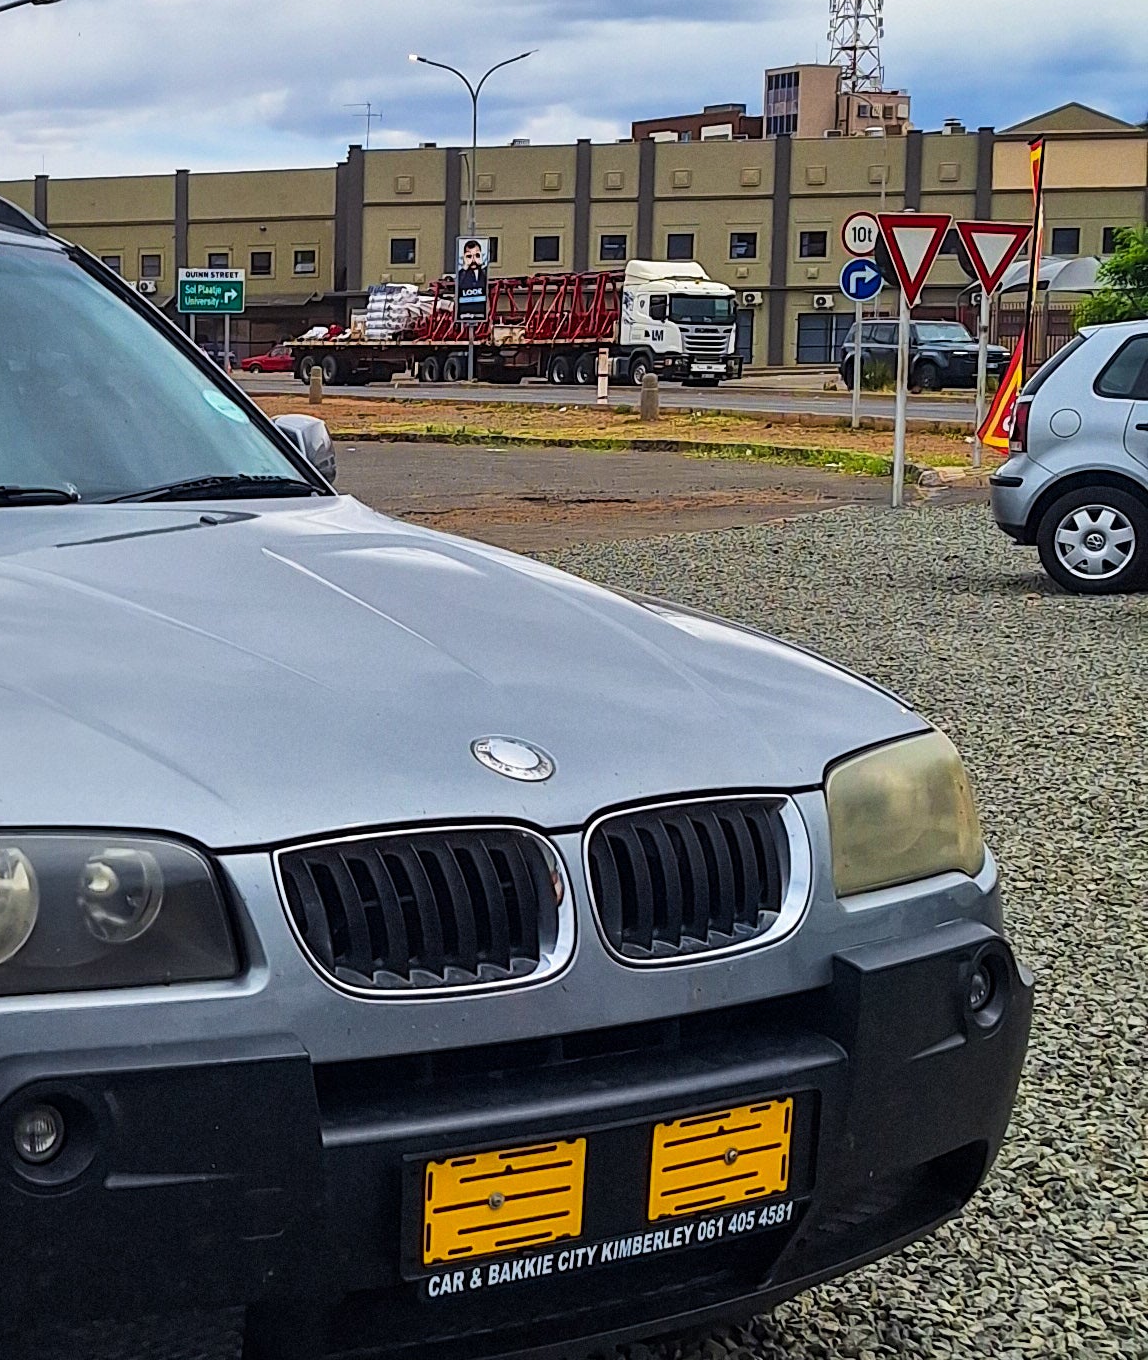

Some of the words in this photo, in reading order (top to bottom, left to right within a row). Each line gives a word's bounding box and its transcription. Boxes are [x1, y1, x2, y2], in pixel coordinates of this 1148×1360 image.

[851, 226, 873, 243] 10t
[185, 271, 209, 279] QUINN
[210, 271, 239, 279] STREET
[184, 284, 197, 294] Sol
[462, 287, 483, 297] LOOK
[184, 296, 220, 308] University
[428, 1271, 465, 1298] CAR
[469, 1267, 483, 1289] &
[487, 1253, 554, 1286] BAKKIE
[557, 1244, 598, 1272] CITY
[600, 1223, 695, 1263] KIMBERLEY
[697, 1216, 724, 1242] 061
[728, 1209, 756, 1234] 405
[758, 1200, 794, 1226] 4581
